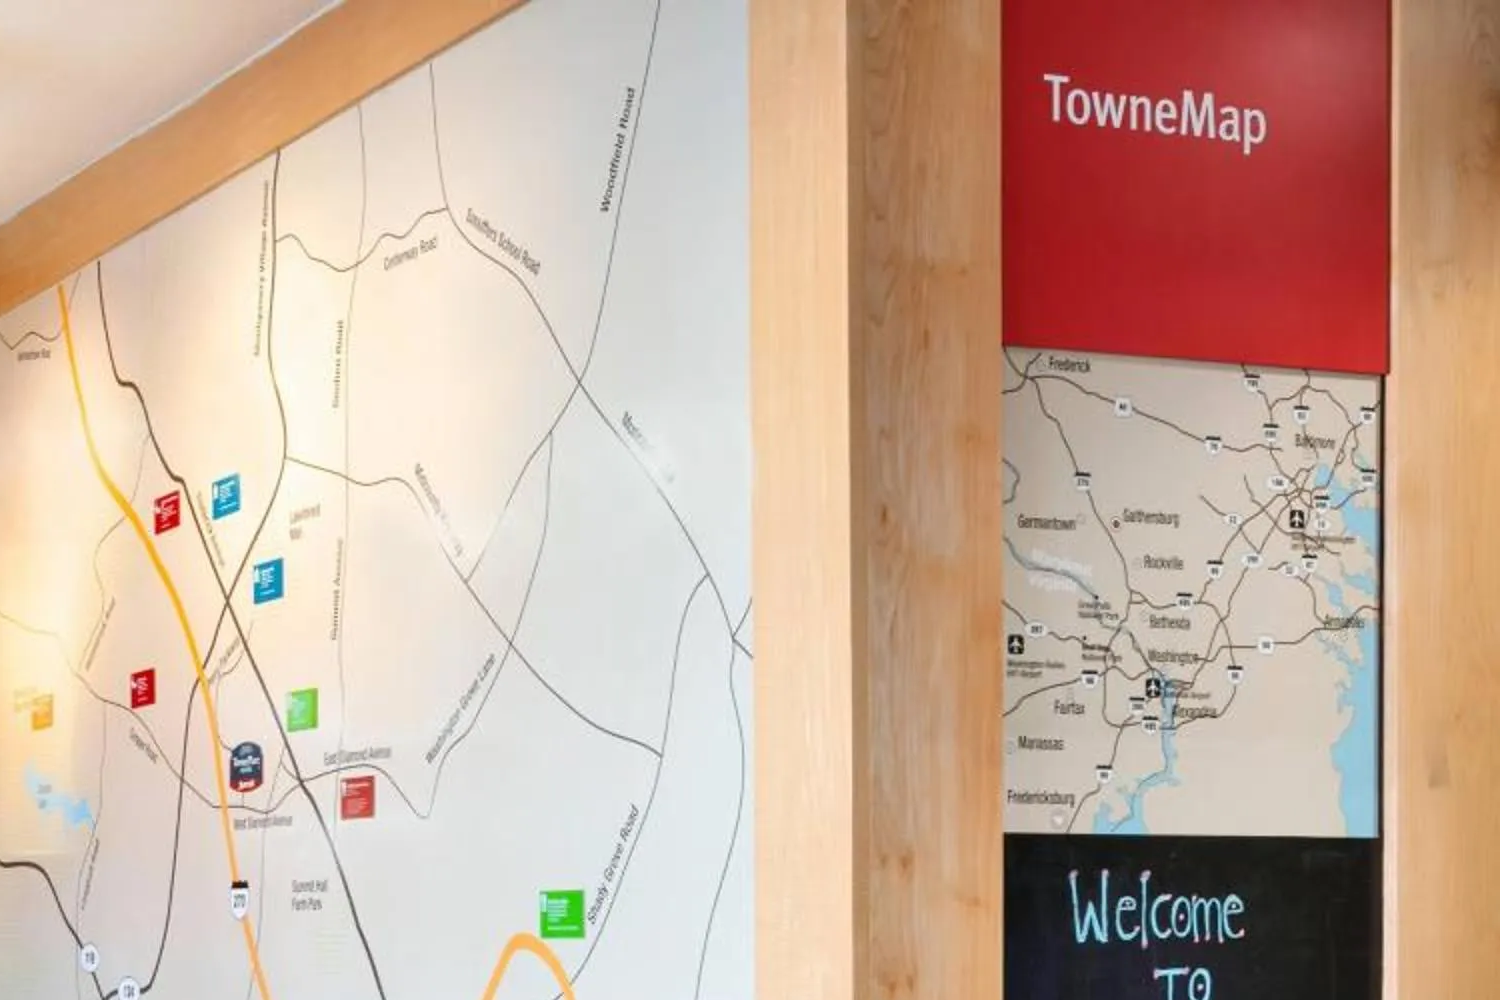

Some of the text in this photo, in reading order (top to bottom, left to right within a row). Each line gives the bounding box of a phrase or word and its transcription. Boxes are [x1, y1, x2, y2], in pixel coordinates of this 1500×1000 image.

[1042, 73, 1268, 156] TowneMap
[600, 87, 635, 212] Woodfield Road
[1048, 355, 1091, 374] Frederick
[1017, 513, 1077, 531] Germantown
[1122, 507, 1181, 529] Gaithersburg
[1143, 554, 1185, 571] Rockville
[1149, 613, 1191, 630] Bethesda
[1148, 649, 1200, 667] Washington
[1054, 699, 1086, 716] Fairfax
[1017, 734, 1065, 752] Manassas
[1007, 789, 1076, 808] Fredericksburg
[587, 803, 639, 925] Shady Grove Road
[1068, 868, 1246, 950] Welcome
